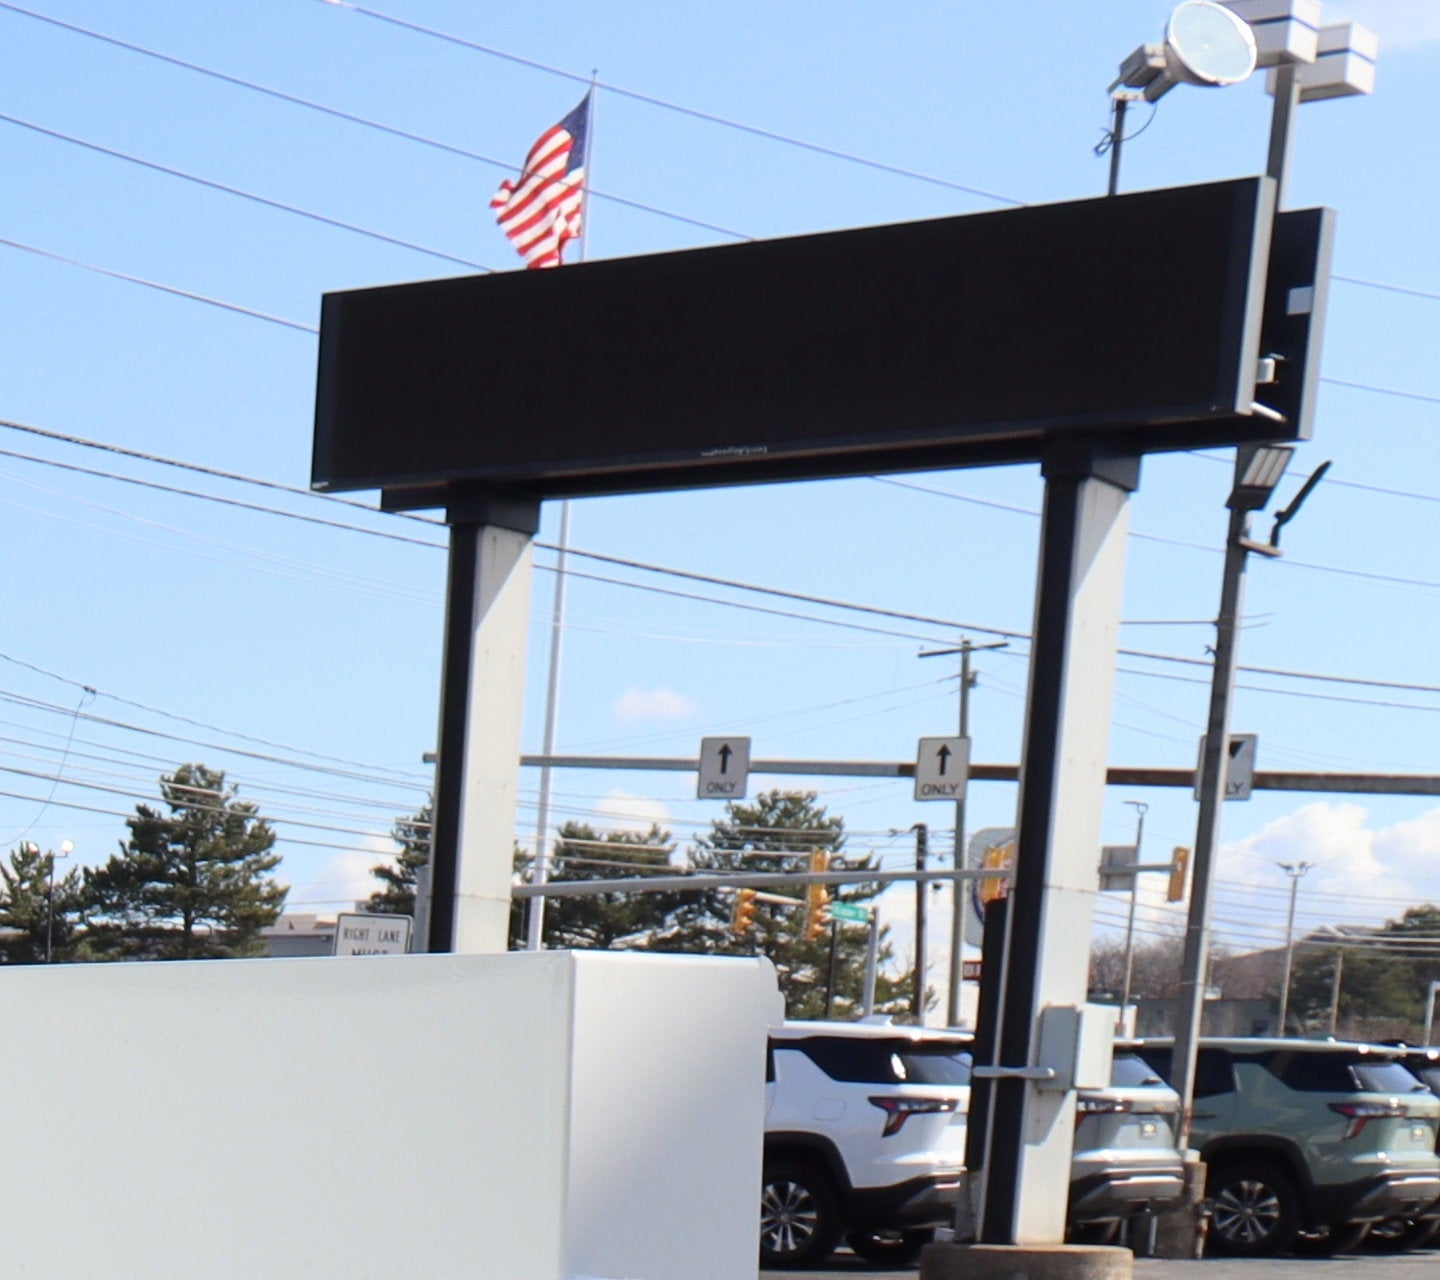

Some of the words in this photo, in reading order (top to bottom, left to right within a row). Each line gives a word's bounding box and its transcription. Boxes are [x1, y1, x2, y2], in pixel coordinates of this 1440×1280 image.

[707, 782, 738, 794] ONLY
[921, 784, 959, 795] ONLY
[344, 927, 370, 940] RIGHT
[378, 930, 401, 942] LANE
